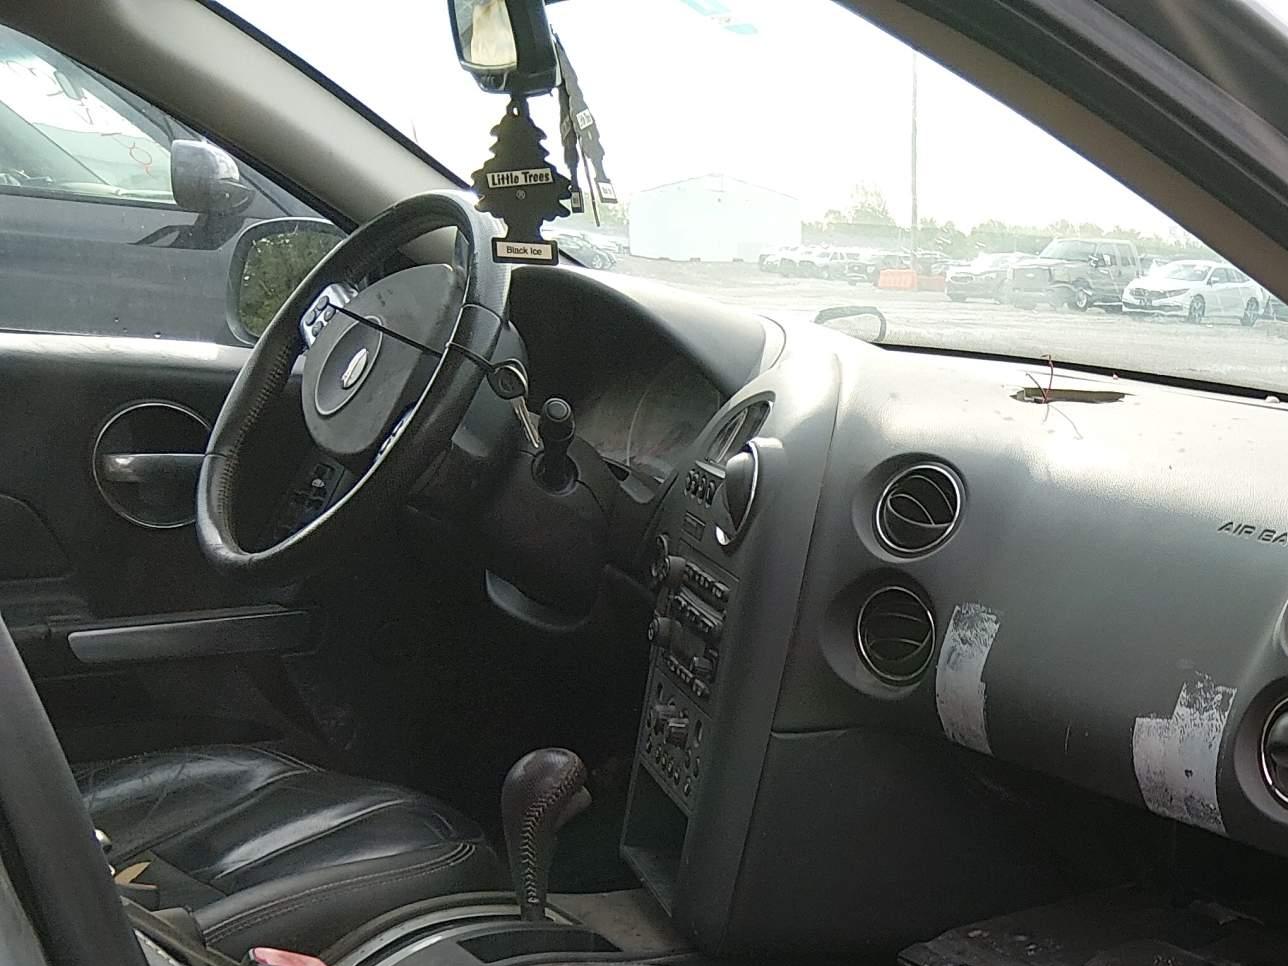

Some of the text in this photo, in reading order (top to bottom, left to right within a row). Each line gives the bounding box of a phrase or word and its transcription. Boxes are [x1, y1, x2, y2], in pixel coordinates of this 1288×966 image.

[491, 171, 550, 186] Little Trees
[506, 246, 542, 256] Black Ice
[1217, 521, 1256, 536] AIR
